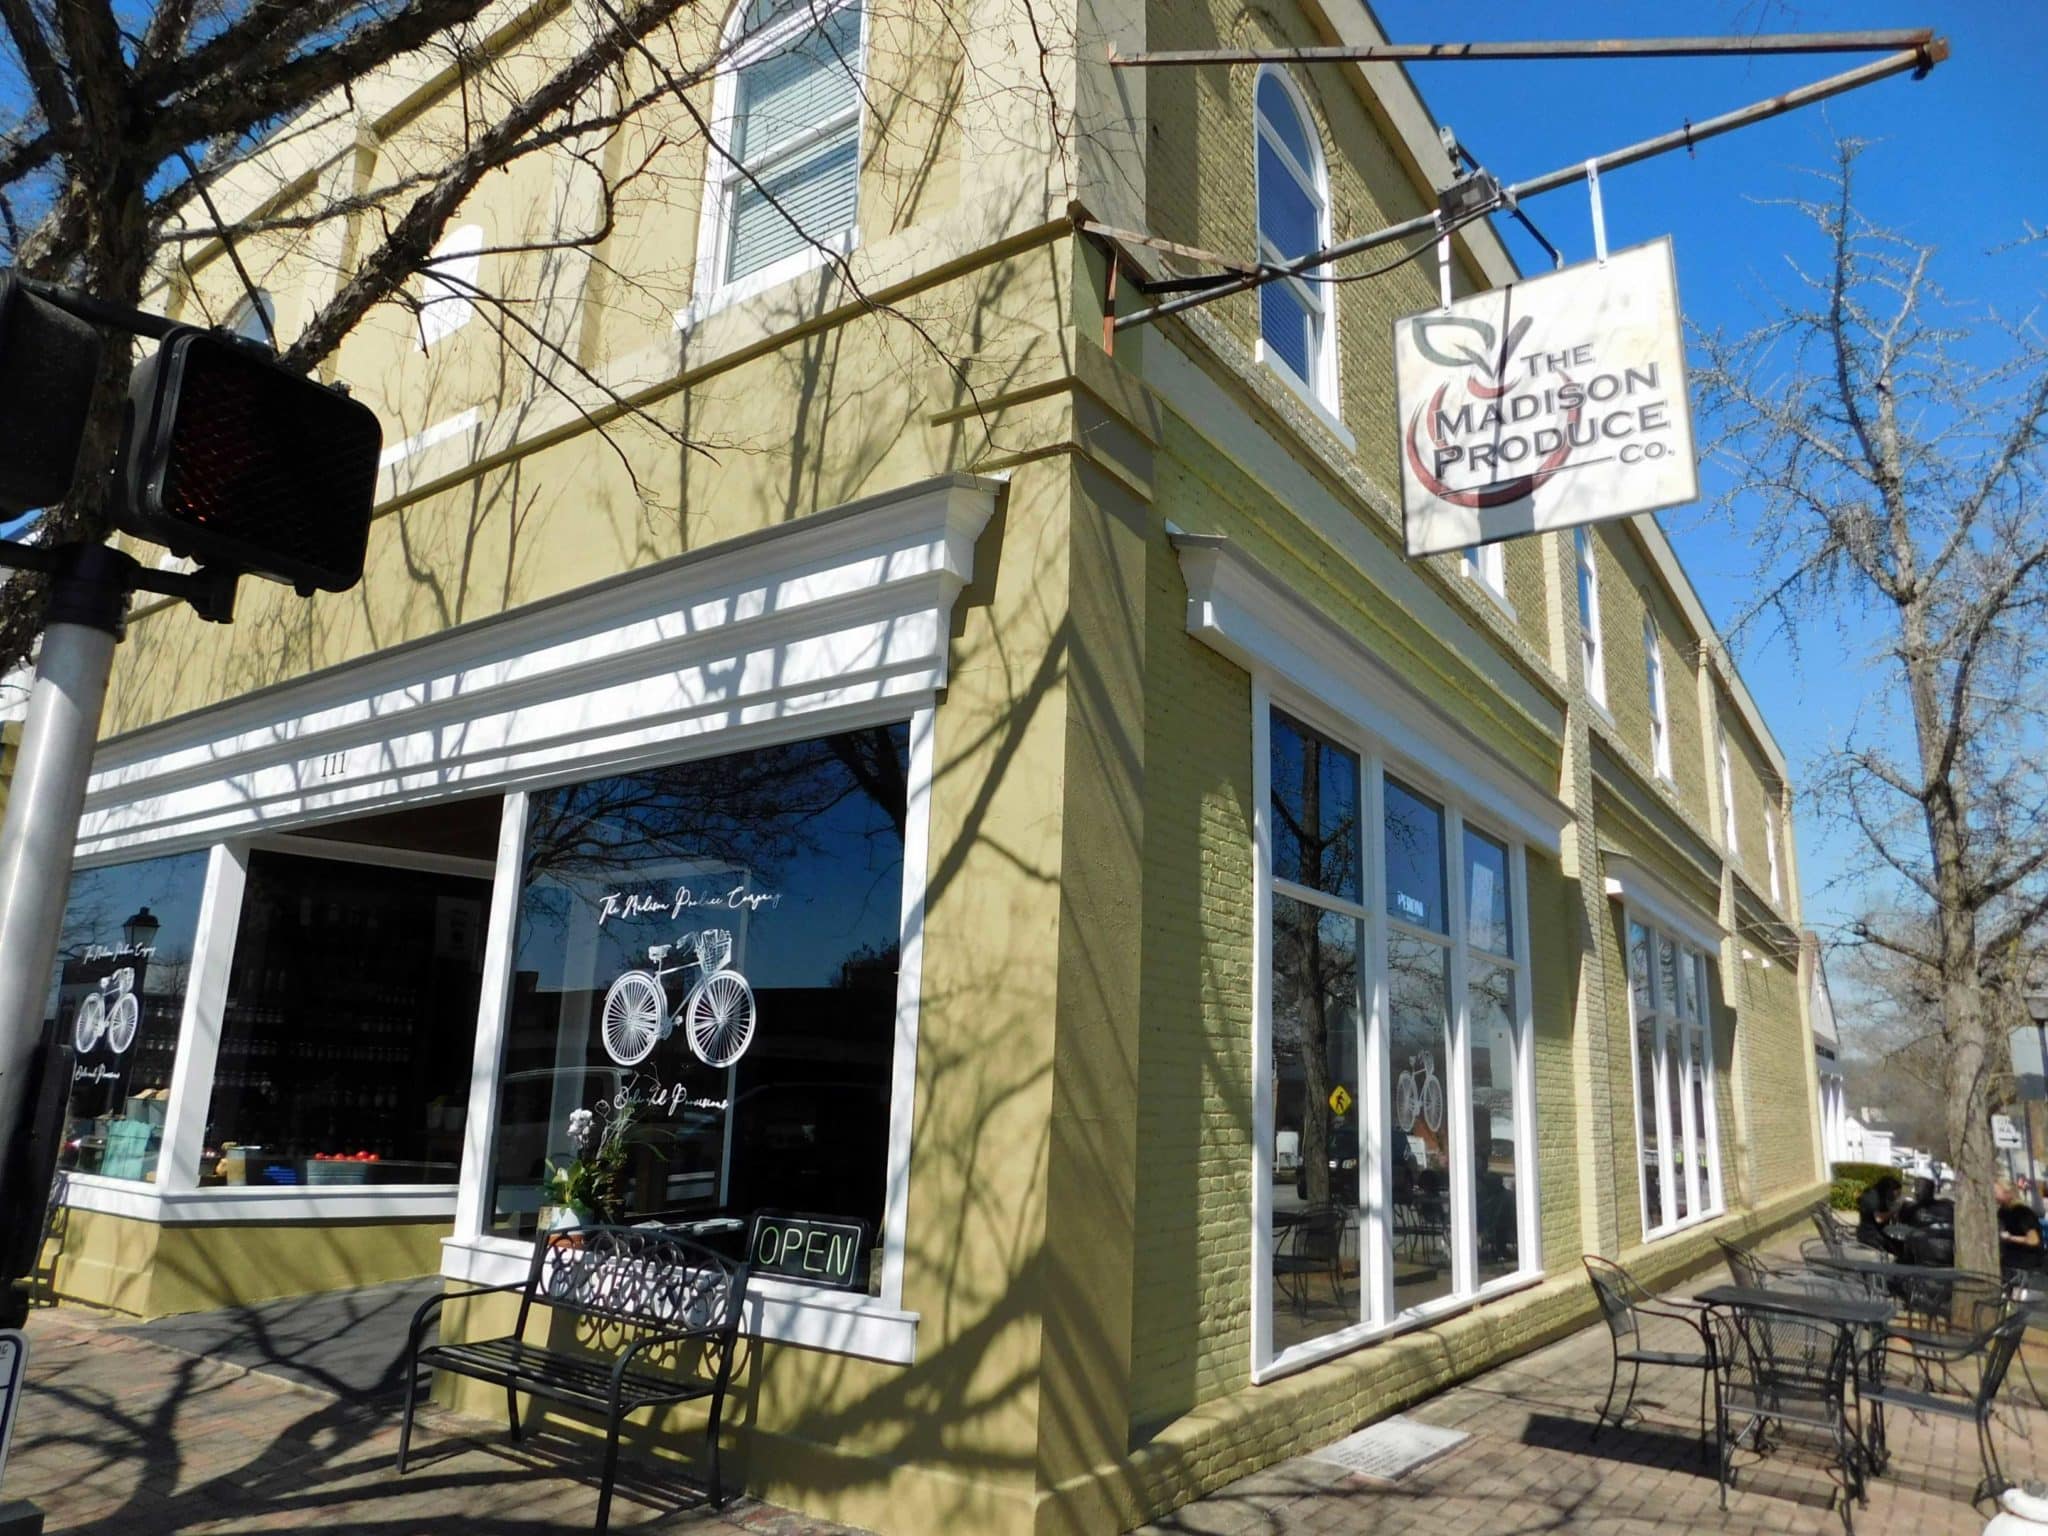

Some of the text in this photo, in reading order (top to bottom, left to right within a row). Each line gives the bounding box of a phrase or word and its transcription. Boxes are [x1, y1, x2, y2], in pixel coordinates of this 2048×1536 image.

[1520, 343, 1596, 377] THE
[1434, 361, 1660, 440] MADISON
[1432, 401, 1671, 480] PRODUCE
[1618, 441, 1676, 465] CO.
[320, 751, 346, 777] 111
[598, 891, 621, 926] The
[758, 1225, 853, 1277] OPEN
